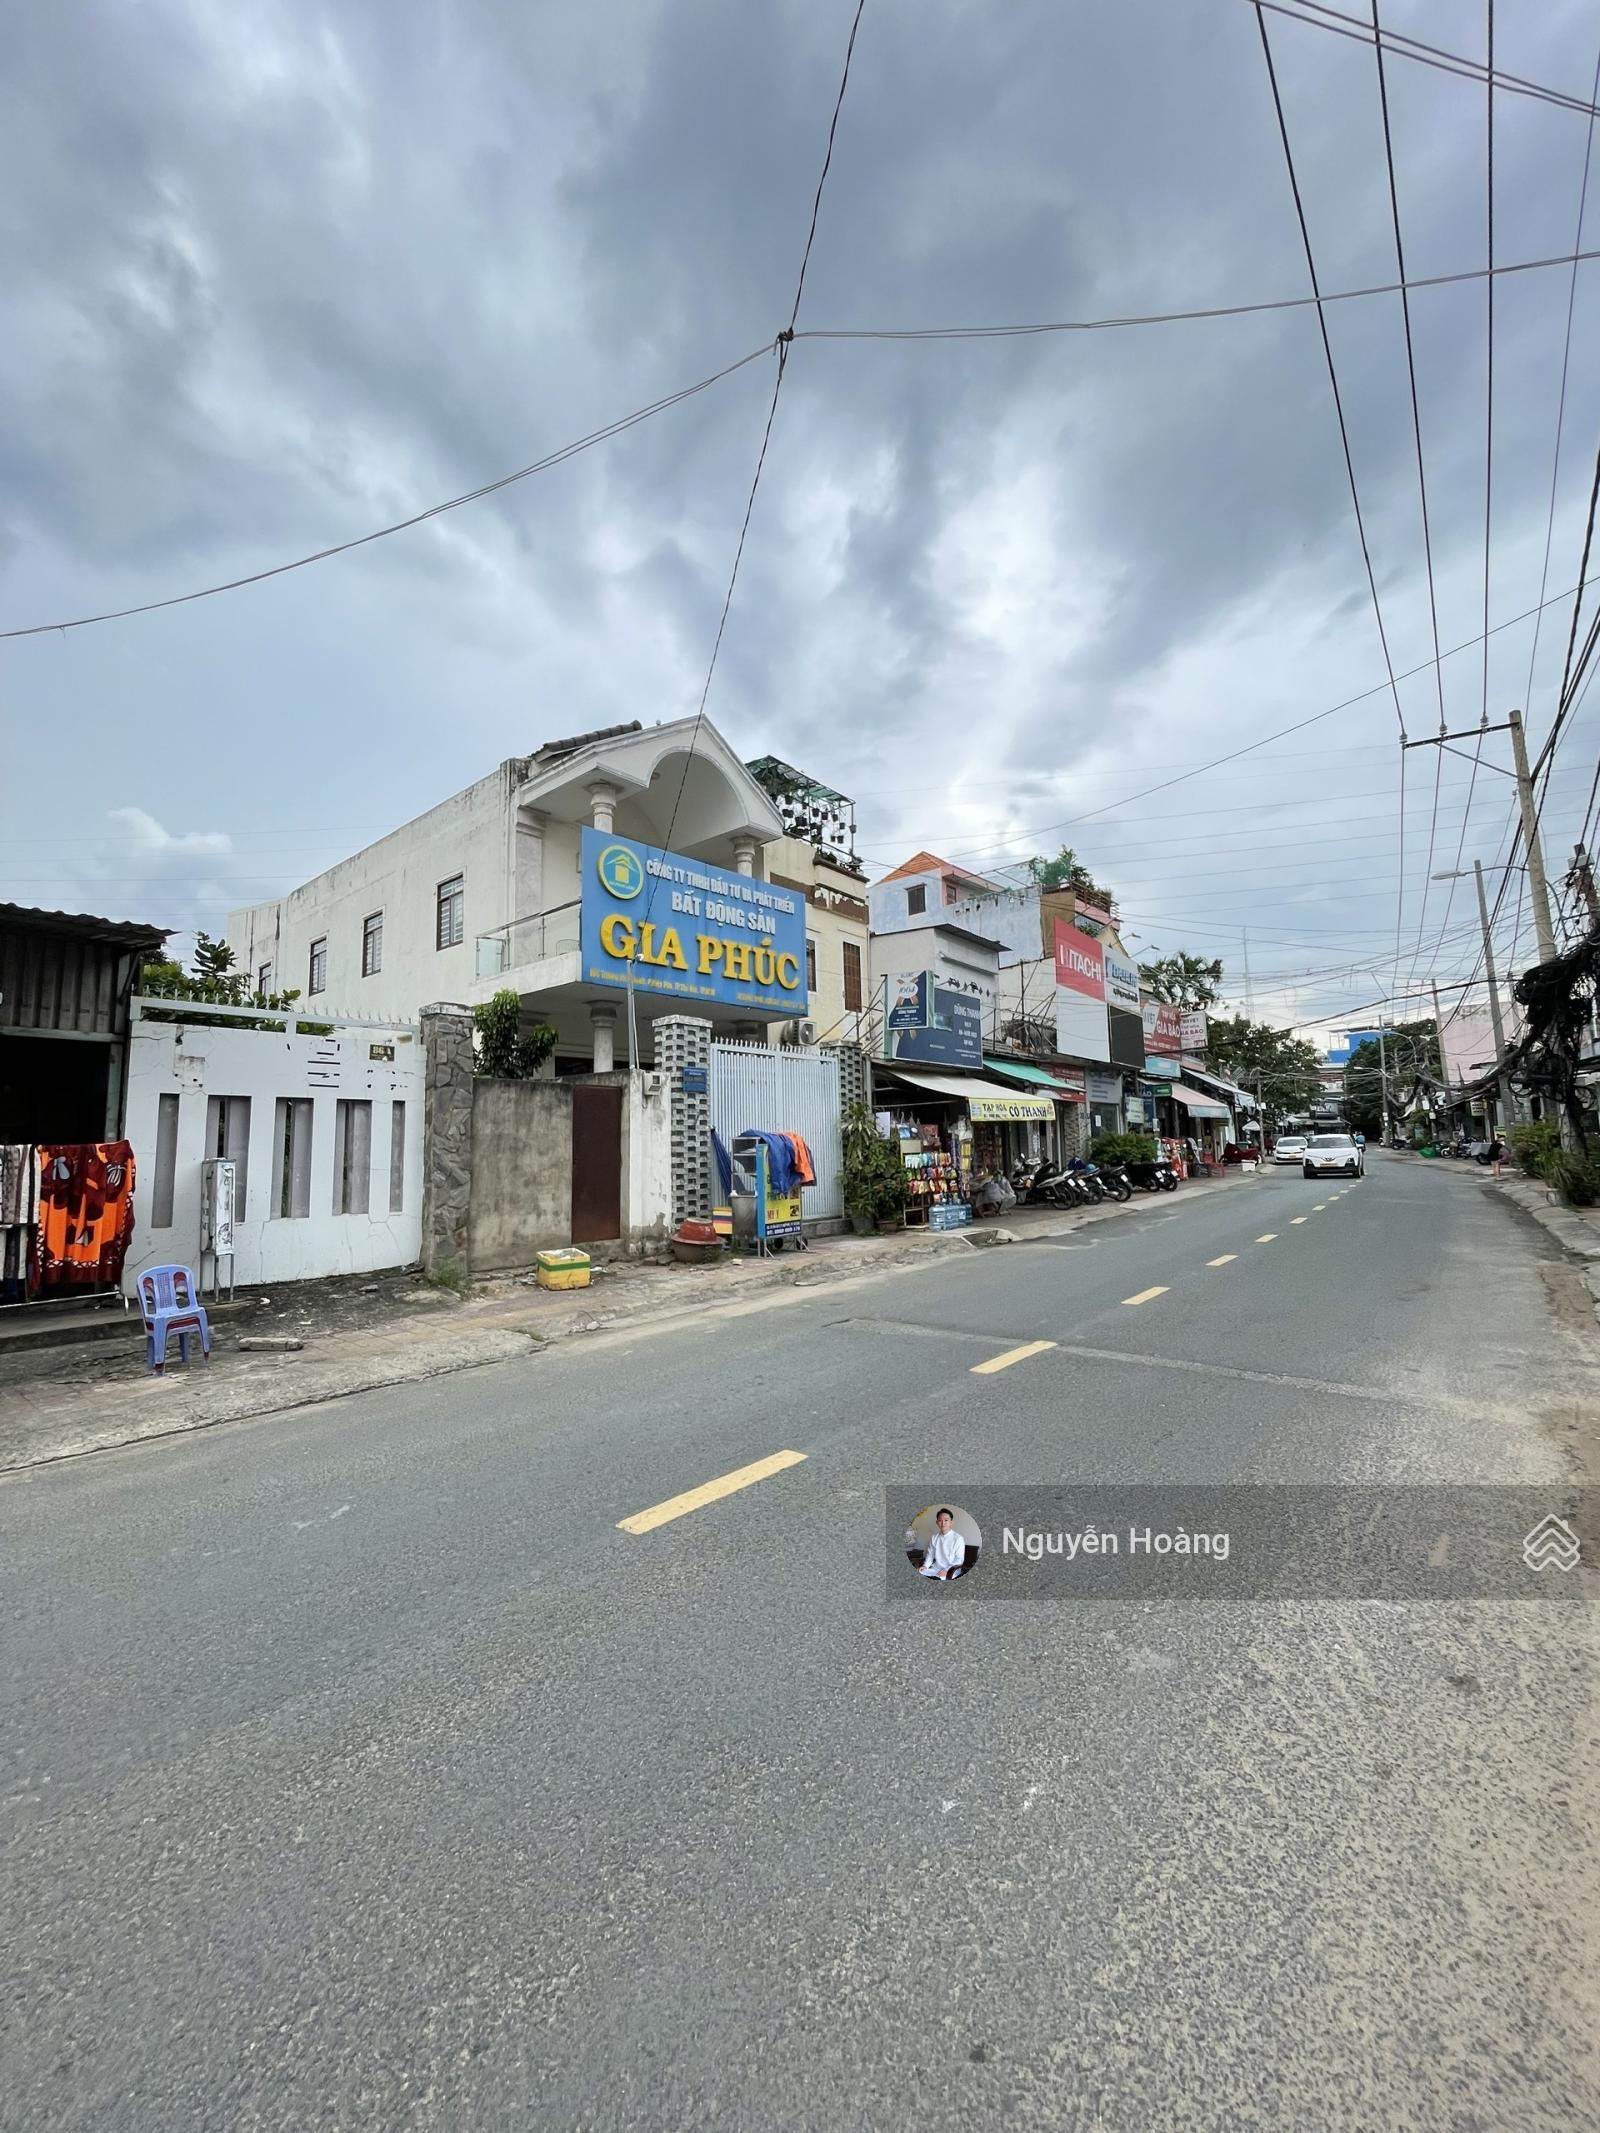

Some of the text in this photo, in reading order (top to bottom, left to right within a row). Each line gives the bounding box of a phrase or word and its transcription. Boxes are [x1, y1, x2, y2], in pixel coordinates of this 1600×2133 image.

[646, 858, 673, 881] CÔNG
[673, 867, 685, 884] TY
[687, 871, 711, 891] TNHH
[729, 883, 741, 899] TƯ
[741, 885, 752, 903] VÀ
[753, 890, 774, 909] PHÁT
[671, 889, 777, 936] BẤT ĐỘNG SẢN
[599, 912, 690, 972] GIA
[695, 936, 800, 991] PHÚC
[1008, 1102, 1047, 1118] CÔ THANH
